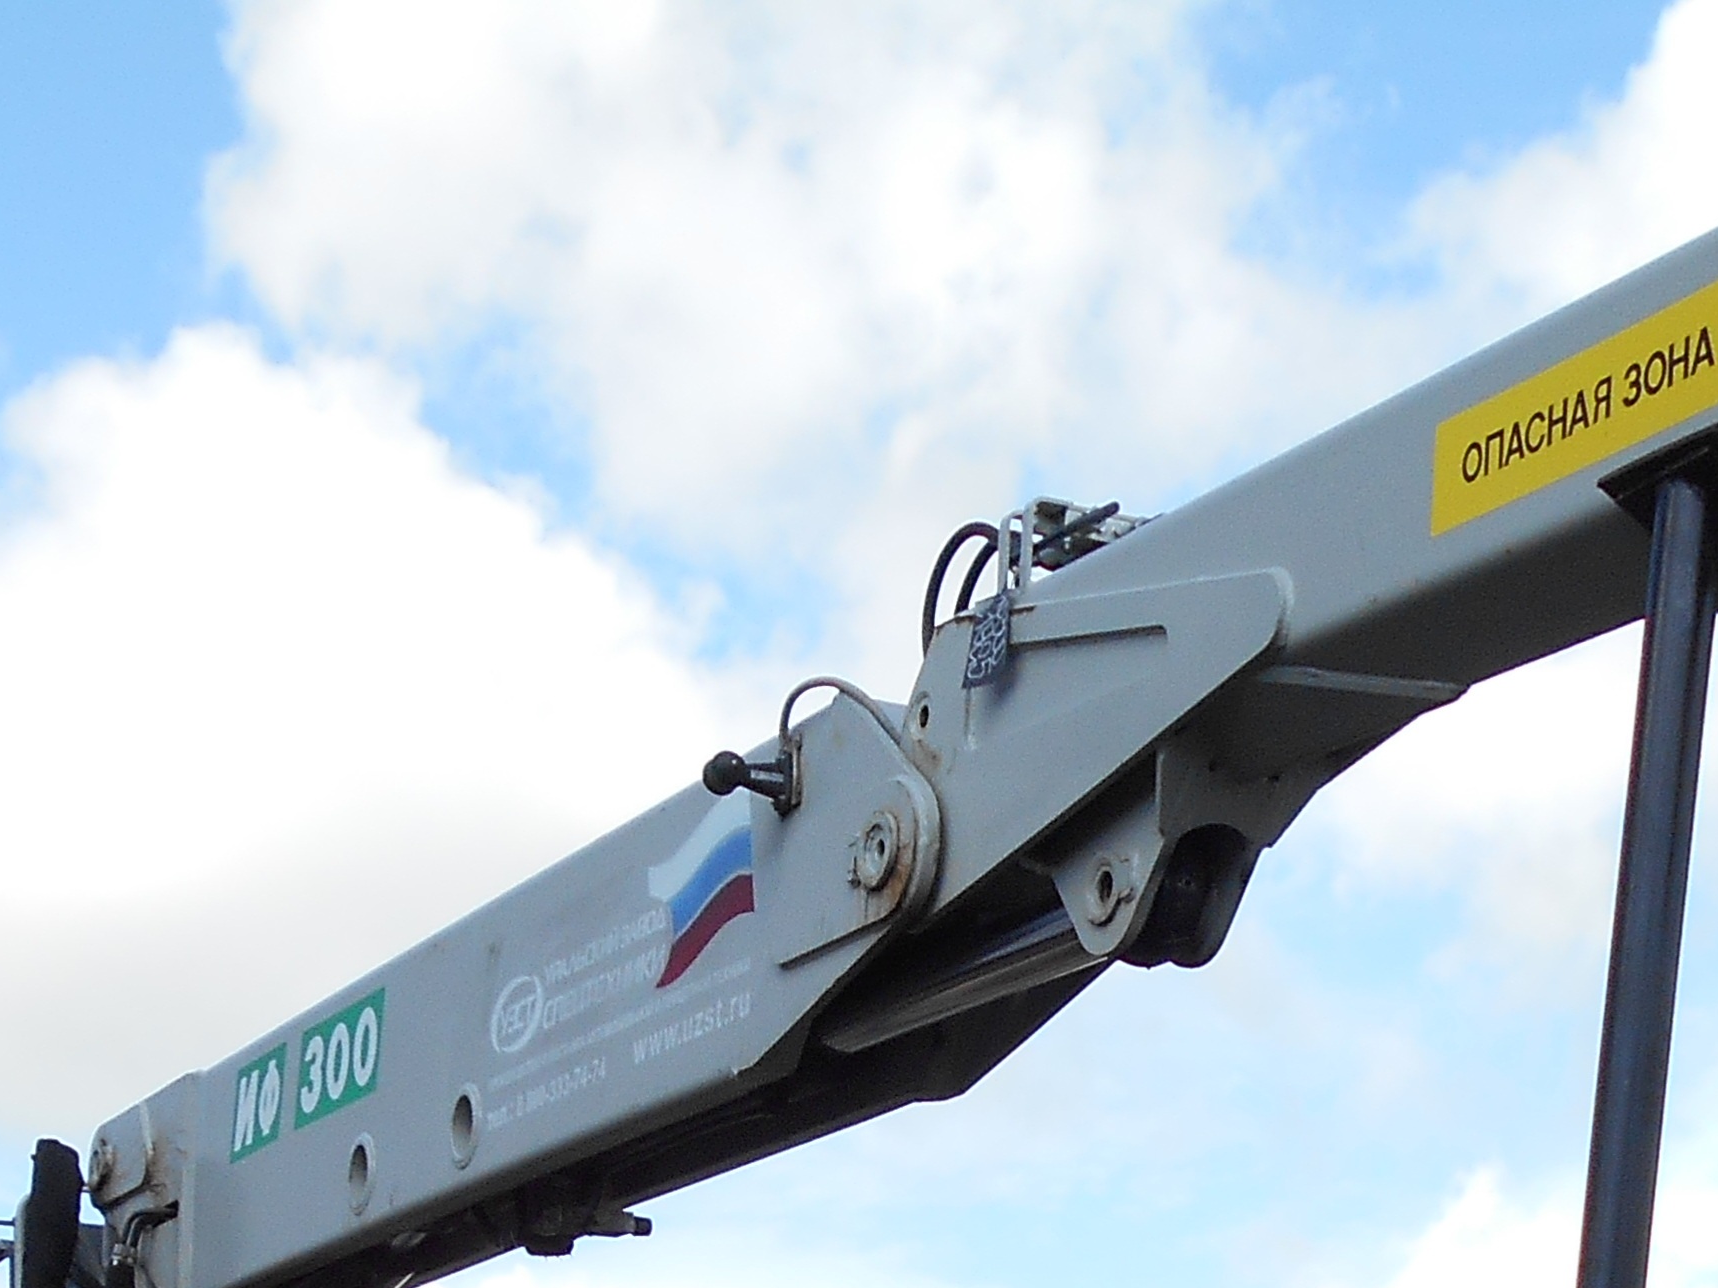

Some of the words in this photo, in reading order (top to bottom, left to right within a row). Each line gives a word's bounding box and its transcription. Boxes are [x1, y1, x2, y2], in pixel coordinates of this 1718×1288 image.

[1461, 376, 1613, 484] ОПАСНАЯ
[1622, 326, 1715, 408] ЗОНА
[233, 1060, 281, 1152] ИФ
[299, 1006, 379, 1114] 300
[633, 994, 752, 1065] www.uzst.ru
